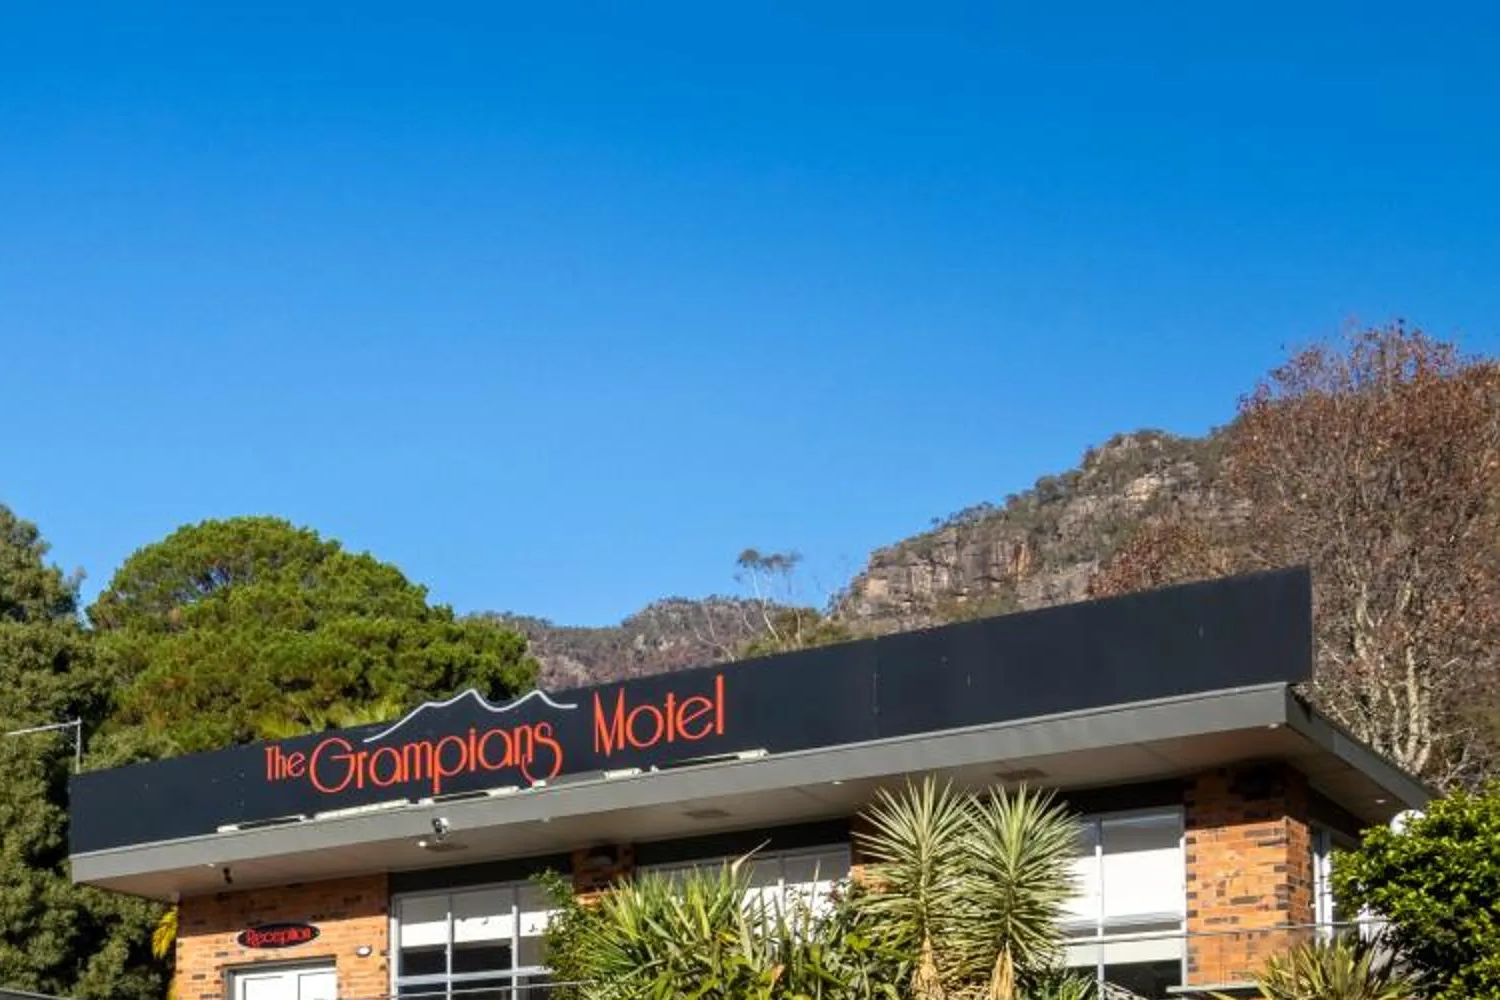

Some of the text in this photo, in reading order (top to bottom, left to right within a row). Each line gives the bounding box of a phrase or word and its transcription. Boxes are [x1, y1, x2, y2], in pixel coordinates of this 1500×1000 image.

[265, 673, 725, 794] The Grampians Motel
